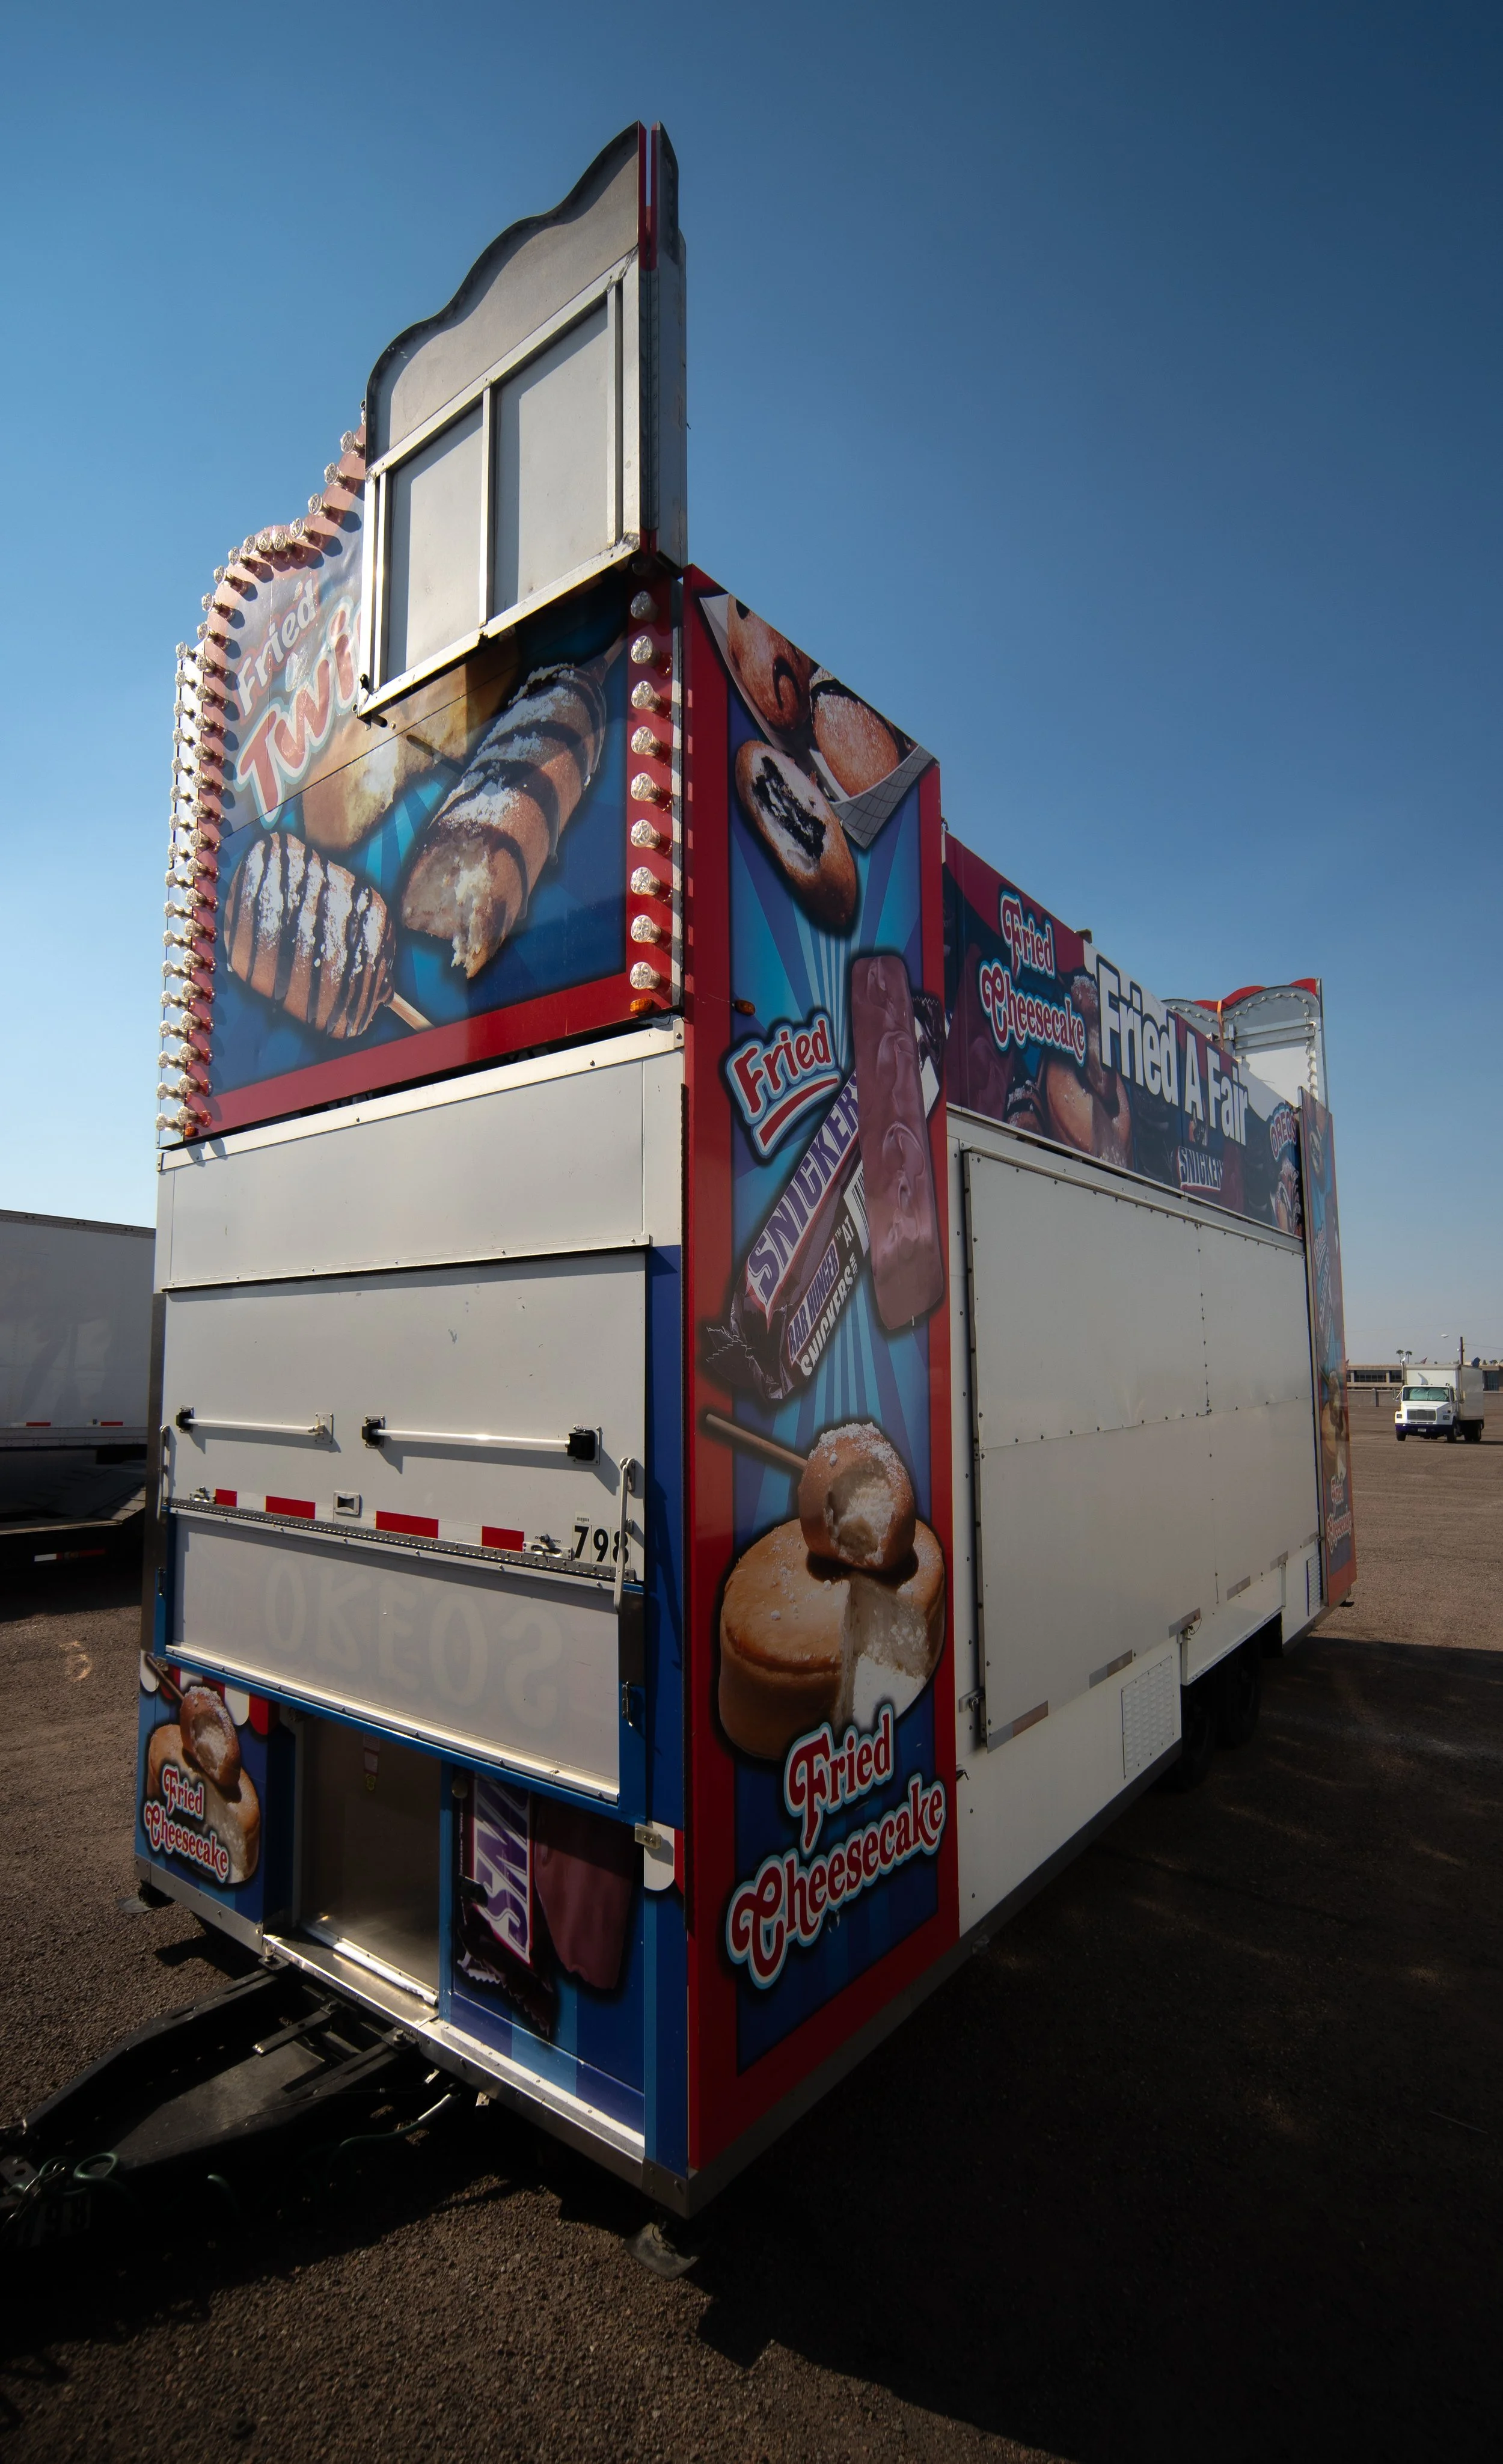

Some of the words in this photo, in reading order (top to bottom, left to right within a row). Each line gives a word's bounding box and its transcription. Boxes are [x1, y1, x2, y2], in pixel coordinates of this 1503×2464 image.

[237, 579, 317, 716] Fried
[237, 602, 362, 823] Twi
[1001, 895, 1055, 979] Fried
[730, 1016, 833, 1117] Fried
[981, 962, 1085, 1064] Cheesecake
[1098, 961, 1179, 1106] Fried
[1184, 1030, 1204, 1122] A
[1207, 1046, 1248, 1146] Fair
[748, 1071, 859, 1304] SNICKER
[787, 1304, 810, 1361] BAR
[806, 1243, 839, 1323] HUNGER
[842, 1215, 854, 1248] AT
[574, 1525, 629, 1563] 798
[144, 1802, 228, 1881] Cheesecake
[163, 1765, 204, 1819] Fried
[788, 1709, 892, 1850] Fried
[729, 1778, 944, 1982] Cheesecake
